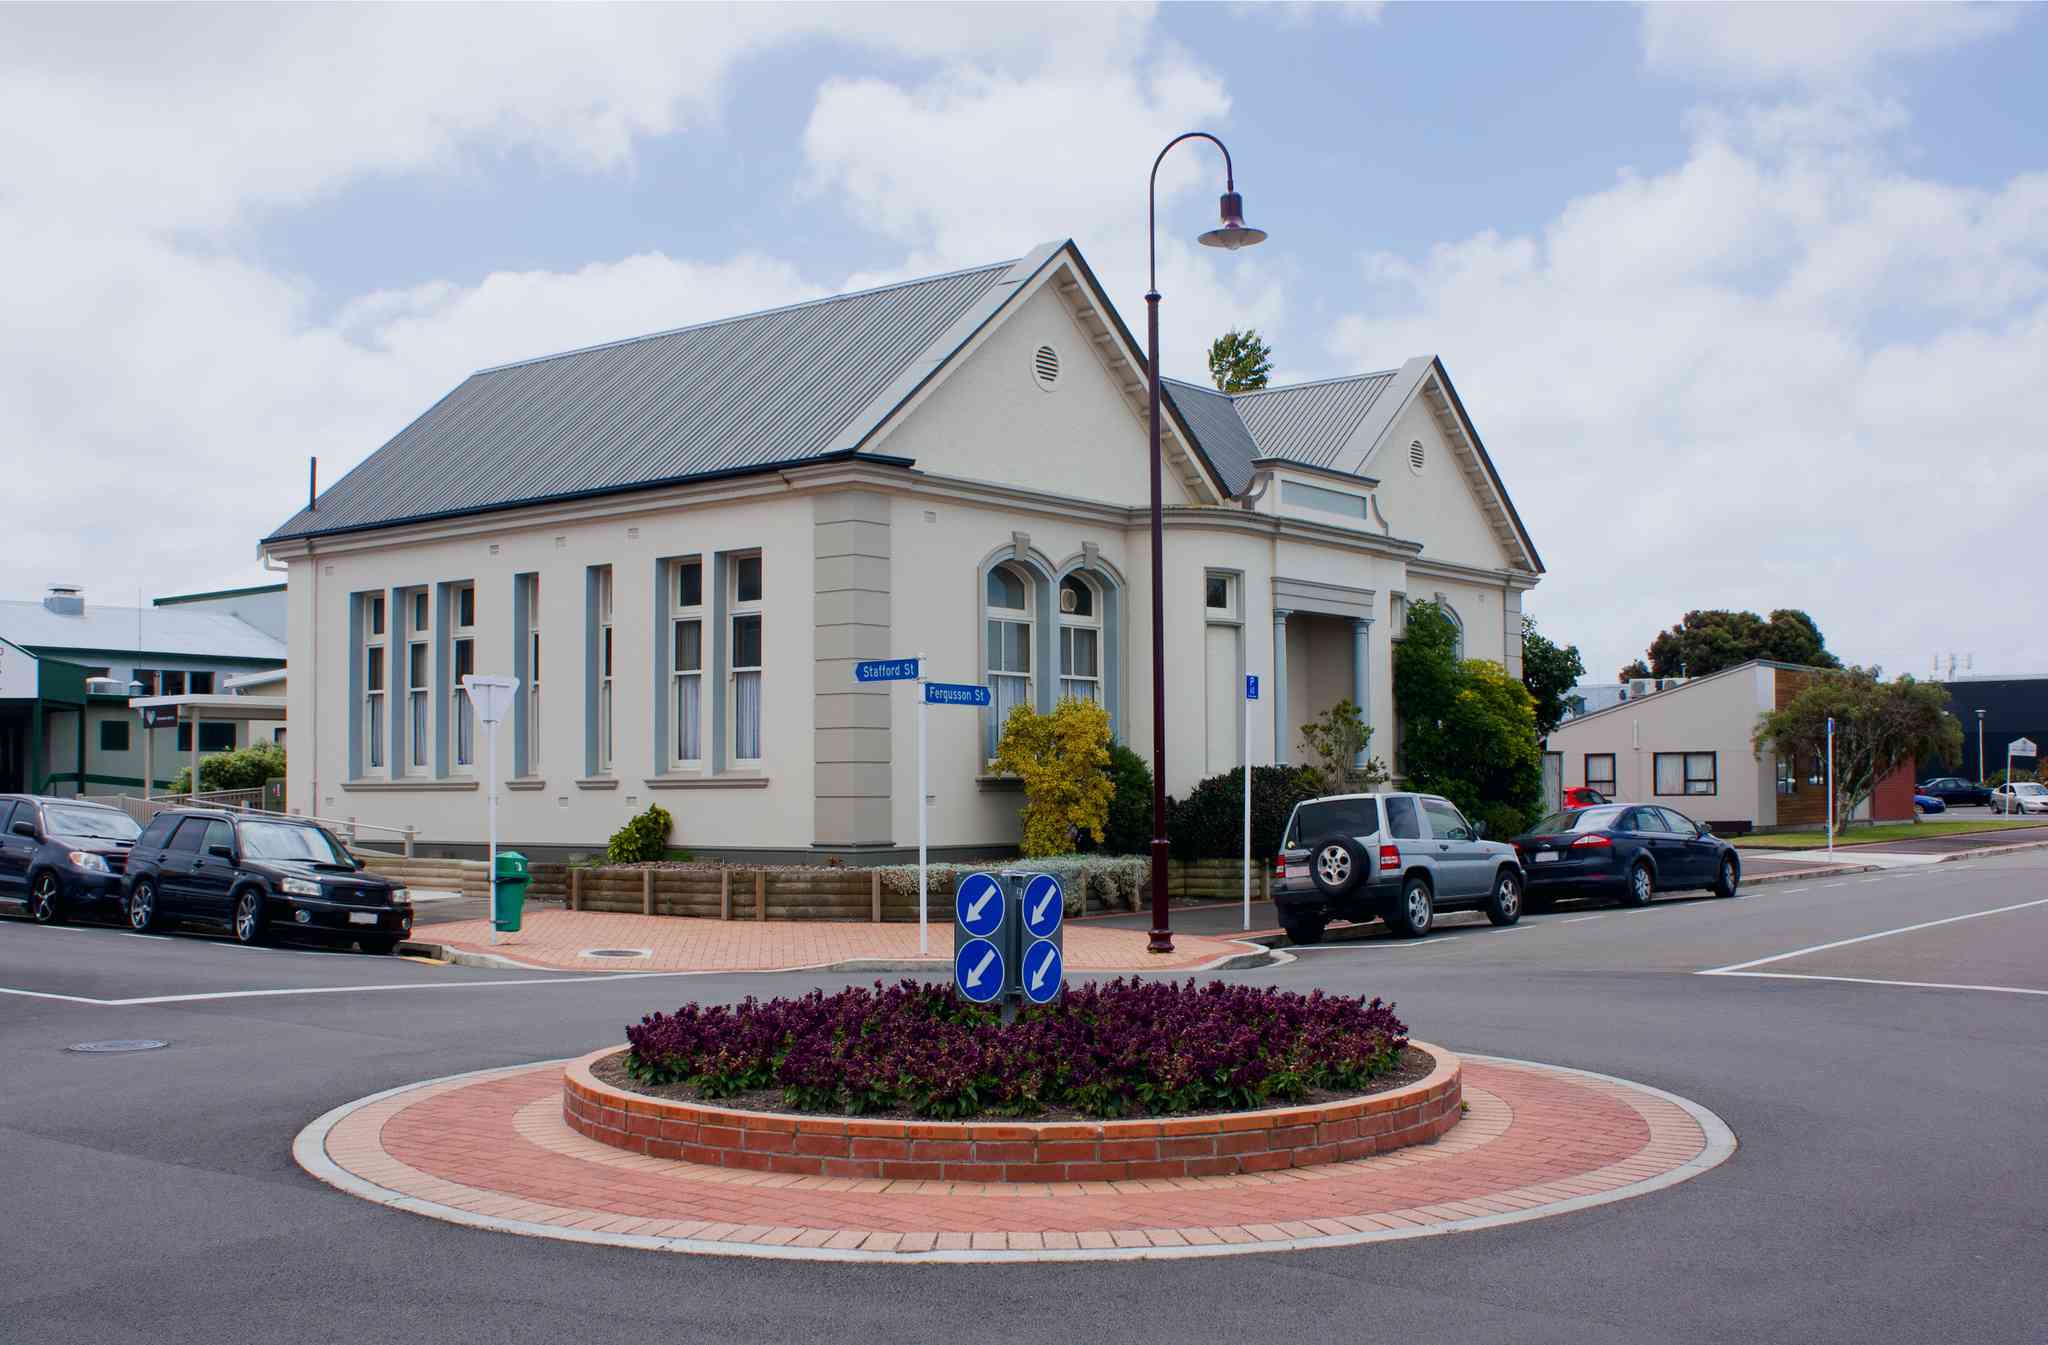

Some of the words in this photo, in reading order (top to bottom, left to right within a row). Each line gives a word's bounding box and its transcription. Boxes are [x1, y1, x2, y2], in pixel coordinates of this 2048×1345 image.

[863, 664, 901, 678] Stafford
[904, 663, 914, 676] St
[929, 686, 972, 702] Fergusson
[975, 689, 984, 701] St
